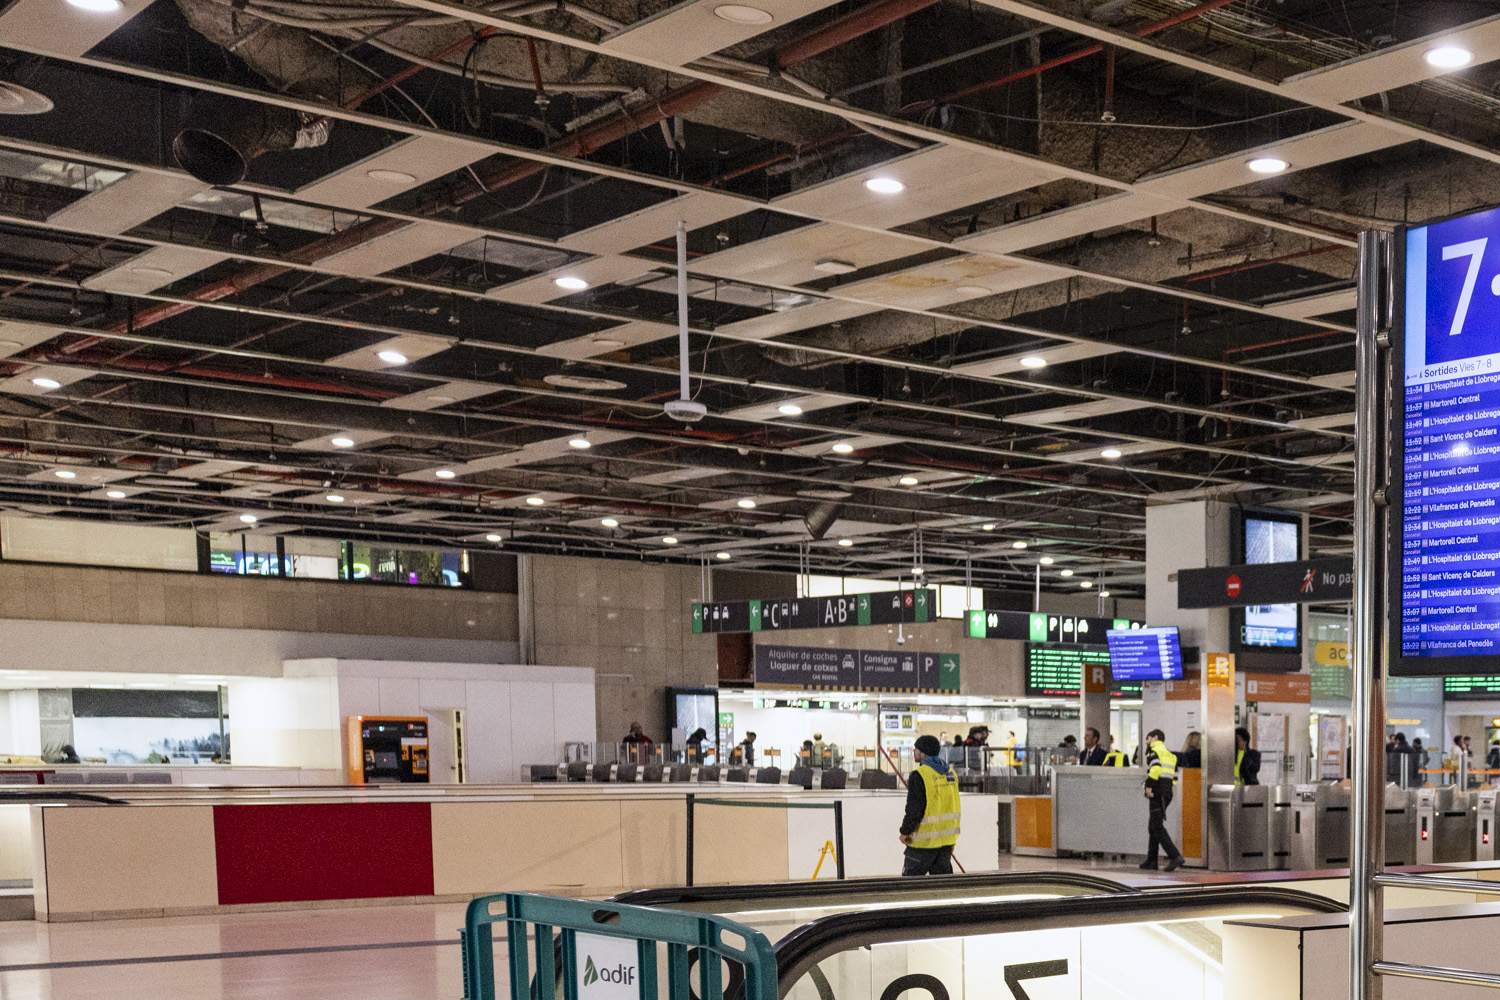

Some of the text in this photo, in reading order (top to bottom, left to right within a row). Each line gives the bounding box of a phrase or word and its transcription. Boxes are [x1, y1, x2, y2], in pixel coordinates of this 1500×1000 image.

[1424, 359, 1492, 378] Sortides Vies 7 8
[1430, 378, 1465, 391] L'Hospitalet
[1431, 397, 1457, 409] Martorell
[1458, 394, 1480, 404] Central
[1430, 414, 1465, 427] L'Hospitalet
[1430, 435, 1444, 444] Sant
[1444, 432, 1464, 442] Vicenç
[1472, 428, 1497, 437] Calders
[1429, 468, 1456, 478] Martorell
[1457, 465, 1479, 474] Central
[1429, 485, 1464, 497] L'Hospitalet
[1429, 503, 1458, 513] Vilafranca
[1469, 498, 1496, 508] Penedès
[1429, 521, 1463, 532] L'Hospitalet
[1428, 539, 1456, 548] Martorell
[1456, 536, 1478, 544] Central
[1428, 555, 1463, 564] L'Hospitalet
[1472, 552, 1500, 562] Llobregat
[1323, 572, 1336, 584] No
[1428, 573, 1442, 581] Sant
[1442, 572, 1462, 581] Vicenç
[1472, 570, 1496, 578] Calders
[1428, 590, 1462, 600] L'Hospitalet
[1472, 587, 1500, 597] Llobregat
[703, 607, 709, 620] P
[771, 603, 779, 628] C
[1428, 607, 1455, 616] Martorell
[1455, 605, 1478, 614] Central
[1427, 624, 1462, 633] L'Hospitalet
[1471, 622, 1500, 632] Llobregat
[1427, 641, 1456, 649] Vilafranca
[1468, 639, 1494, 648] Penedès
[768, 649, 838, 661] Alquiler de coches
[864, 654, 898, 665] Consigna
[770, 661, 838, 672] Lloguer de cotxes
[925, 656, 933, 672] P
[1216, 657, 1229, 675] R
[1092, 668, 1104, 684] R
[600, 963, 635, 985] adif
